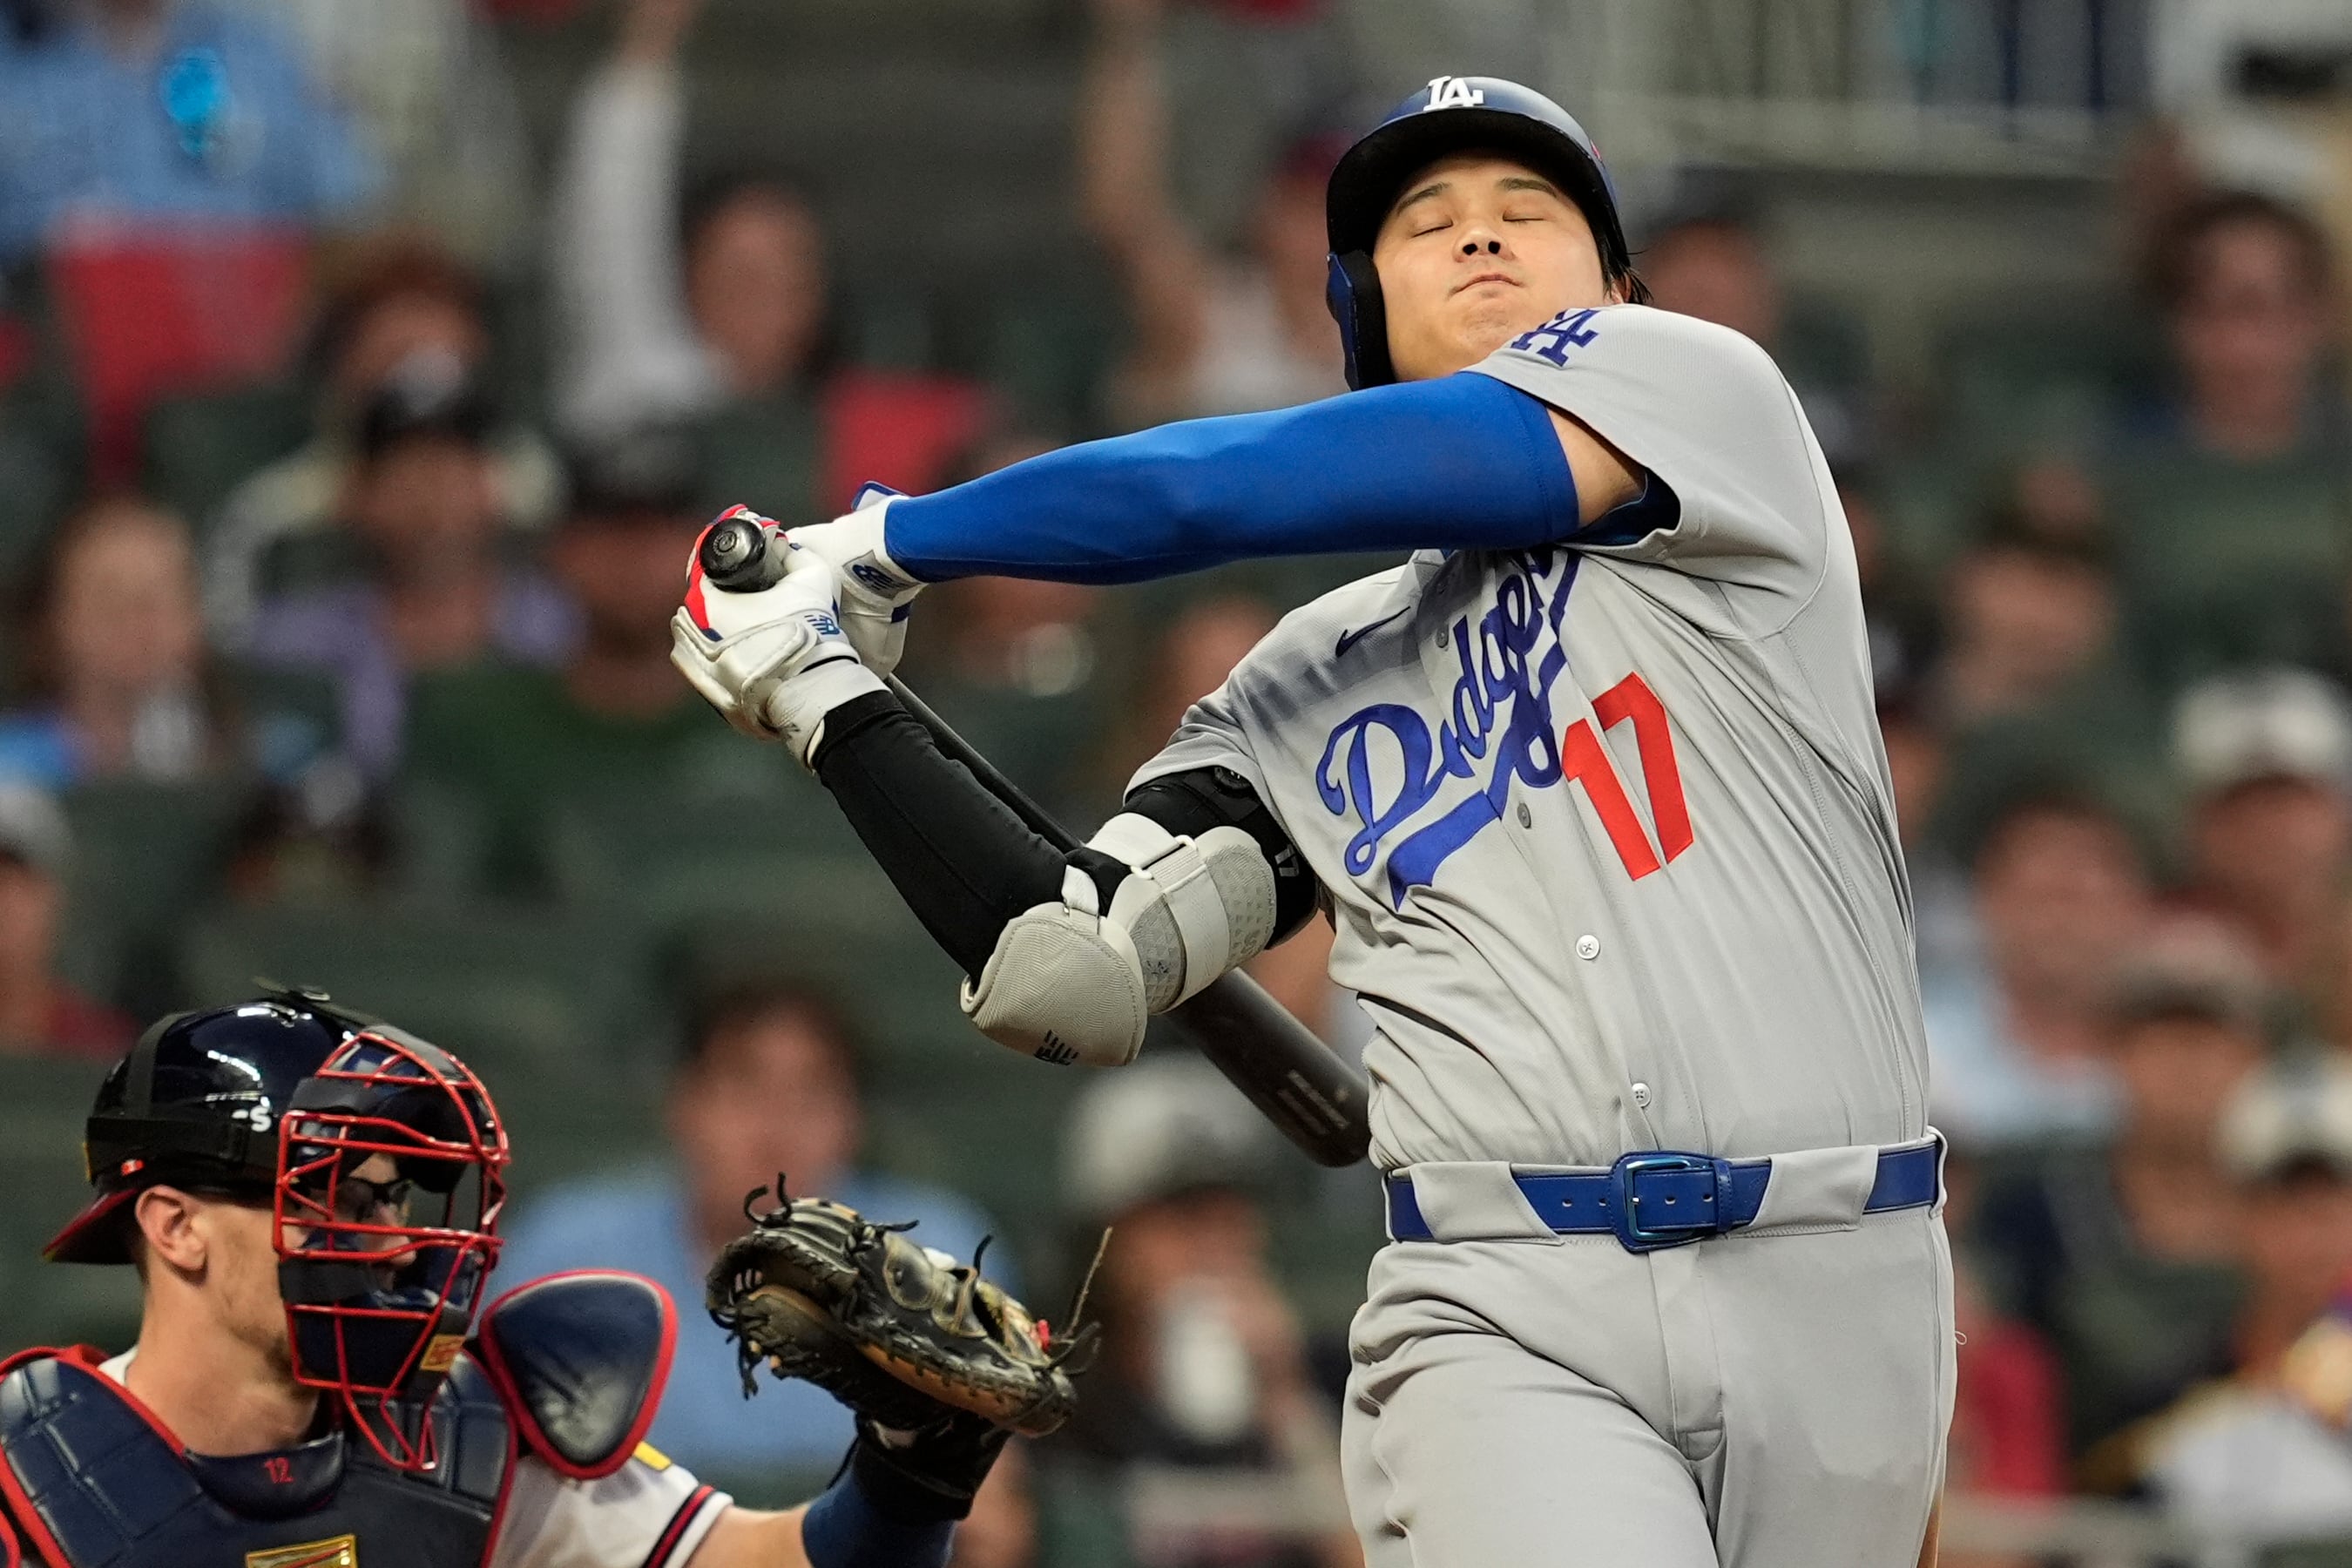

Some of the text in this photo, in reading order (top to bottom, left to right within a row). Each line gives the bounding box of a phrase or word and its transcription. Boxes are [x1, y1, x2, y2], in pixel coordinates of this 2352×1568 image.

[1423, 76, 1484, 112] LA
[1315, 545, 1582, 880] Ddger
[1562, 671, 1694, 882] 17
[264, 1456, 294, 1484] 12
